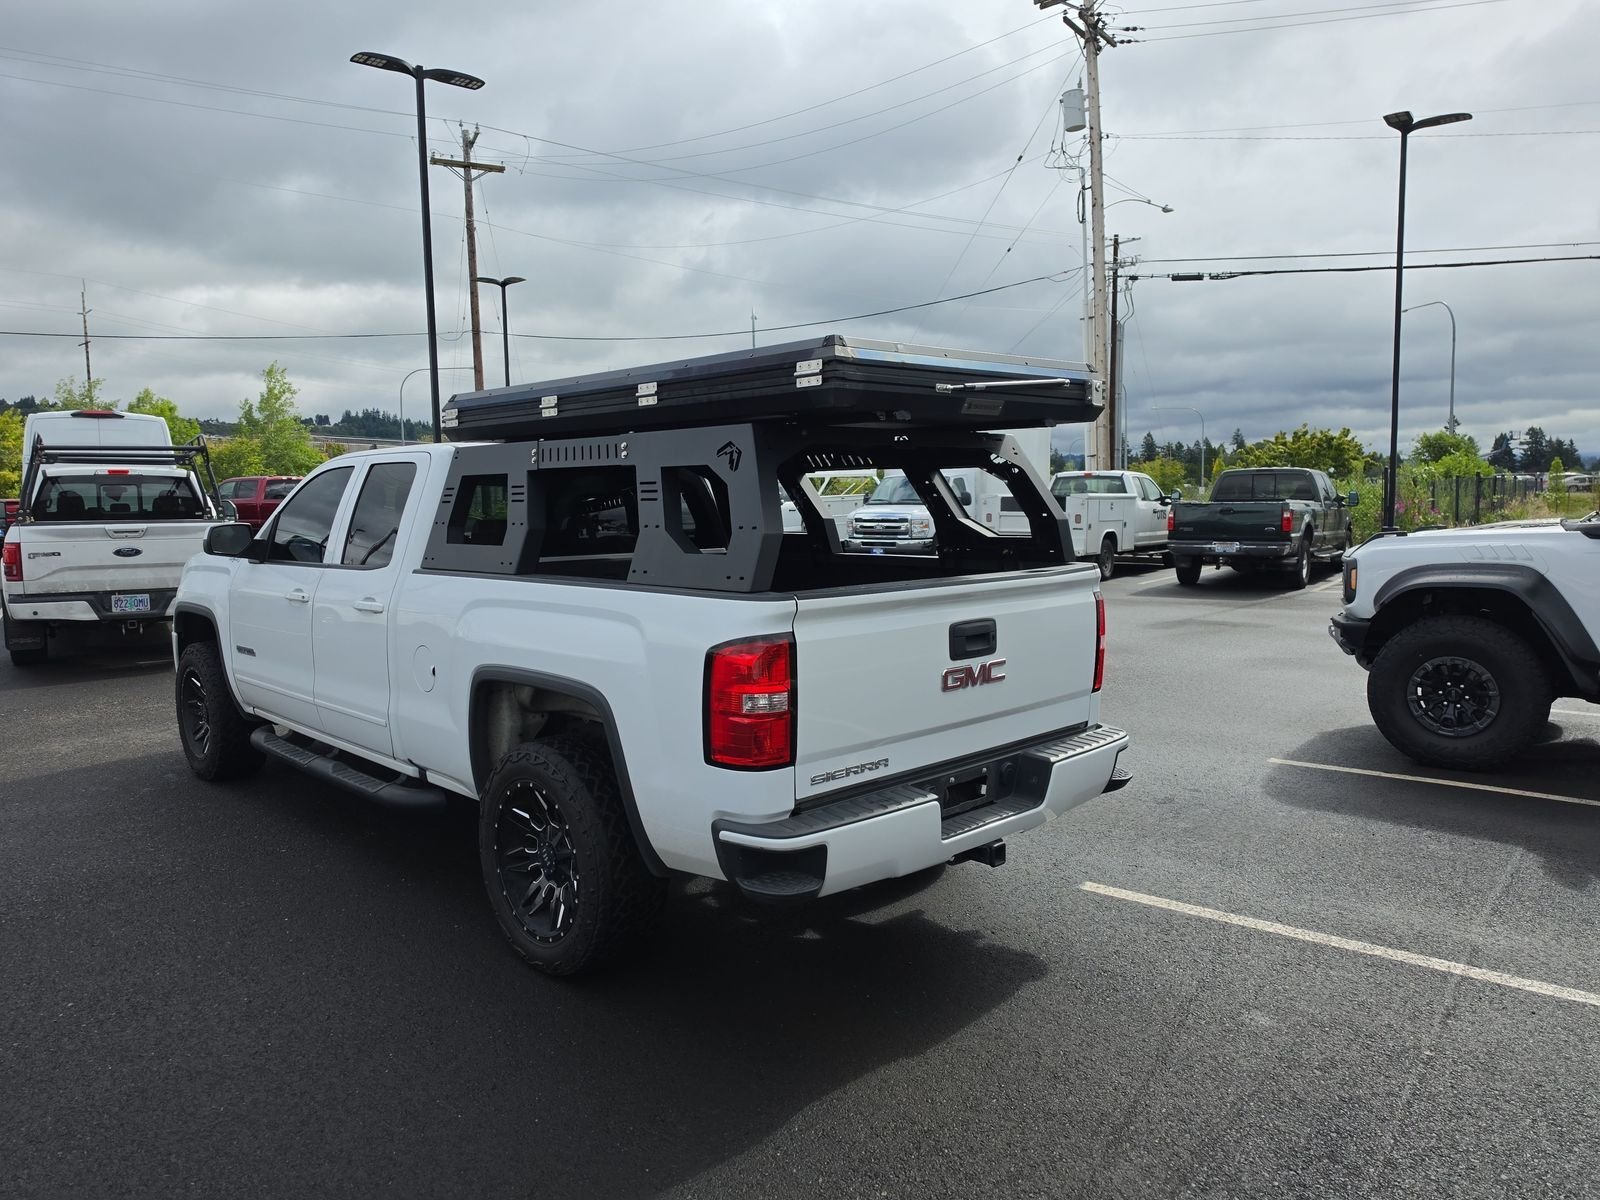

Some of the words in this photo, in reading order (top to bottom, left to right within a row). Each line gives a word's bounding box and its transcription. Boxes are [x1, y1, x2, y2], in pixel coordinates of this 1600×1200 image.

[113, 598, 129, 609] 822
[942, 658, 1007, 692] GMC
[810, 758, 889, 786] SIERRA
